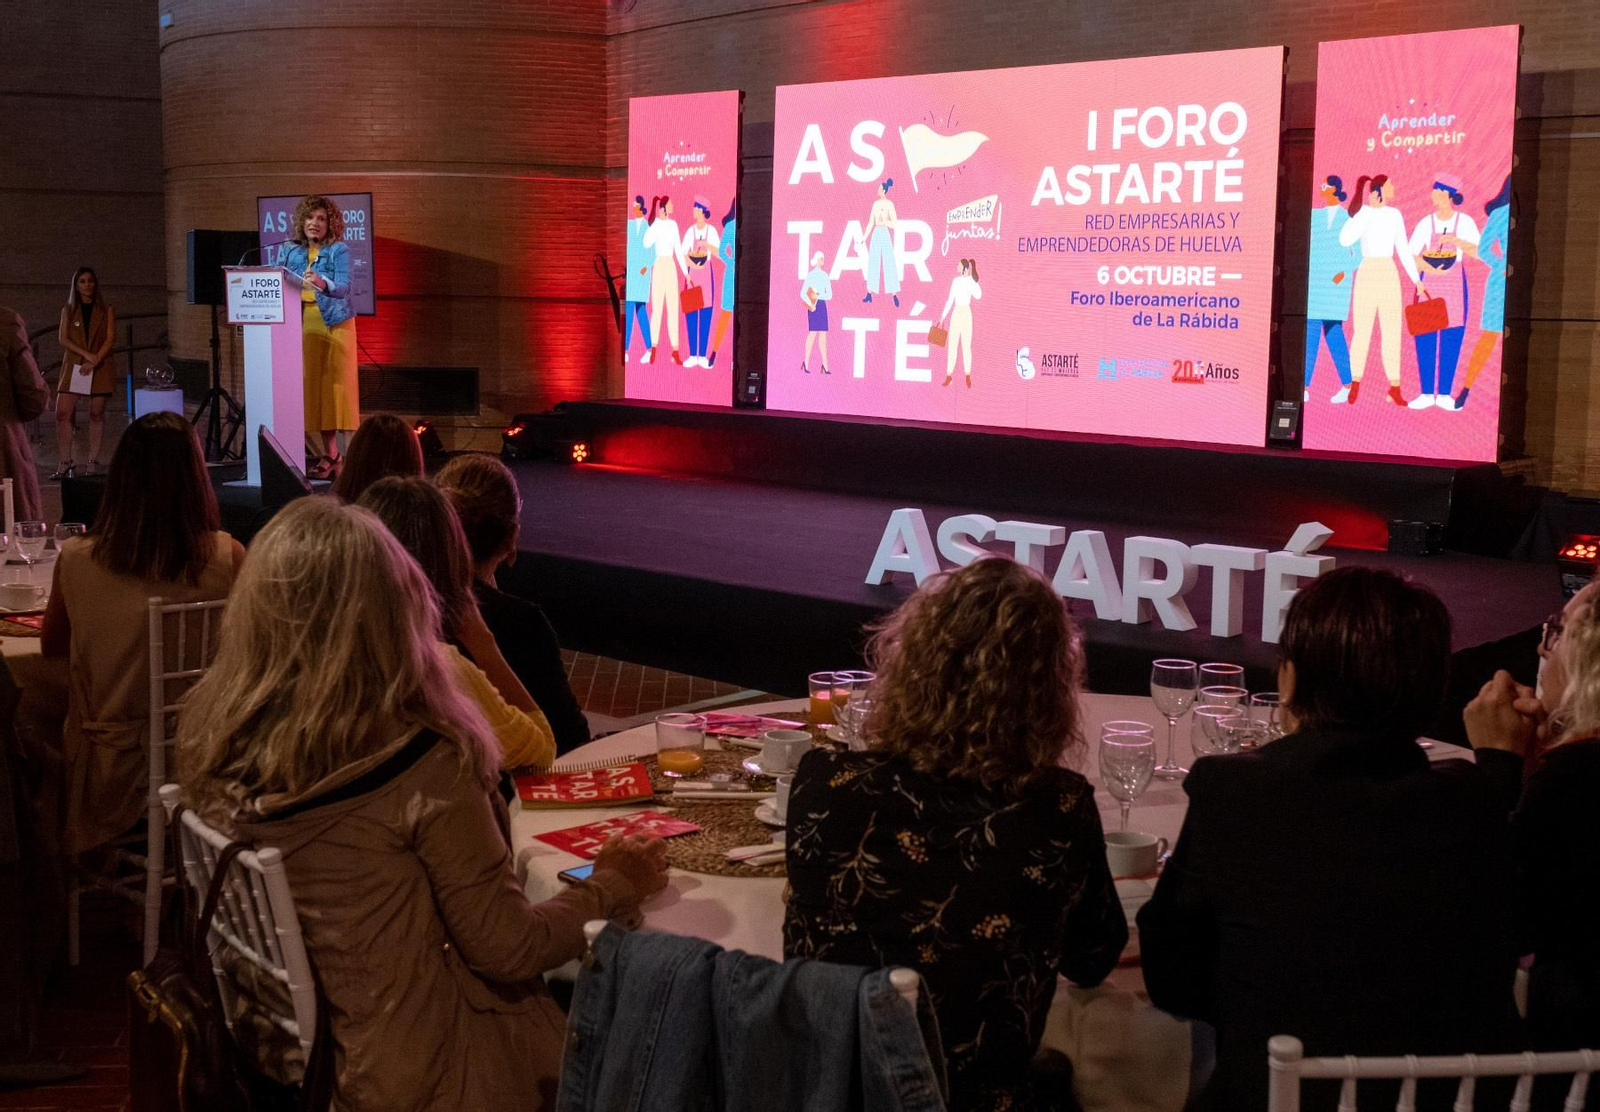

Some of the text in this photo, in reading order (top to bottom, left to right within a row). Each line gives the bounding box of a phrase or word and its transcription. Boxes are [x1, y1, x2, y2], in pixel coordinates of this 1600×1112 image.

[1087, 101, 1248, 151] I FORO
[1378, 113, 1456, 131] Aprender
[1366, 131, 1466, 152] y Compartir
[663, 151, 706, 164] Aprender
[656, 164, 711, 180] y Compartir
[1031, 147, 1245, 206] ASTARTÉ
[342, 208, 365, 224] ORO
[1085, 212, 1241, 231] RED EMPRESARIAS Y
[941, 202, 1003, 257] juntas!
[787, 220, 934, 282] TAR
[1018, 235, 1242, 252] EMPRENDEDORAS DE HUELVA
[255, 278, 280, 288] FORO
[1097, 266, 1216, 286] 6 OCTUBRE
[241, 287, 281, 299] ASTARTÉ
[1070, 291, 1240, 308] Foro Iberoamericano
[1132, 311, 1239, 329] de La Rábida
[1041, 353, 1079, 369] ASTARTÉ
[1205, 362, 1240, 380] Años
